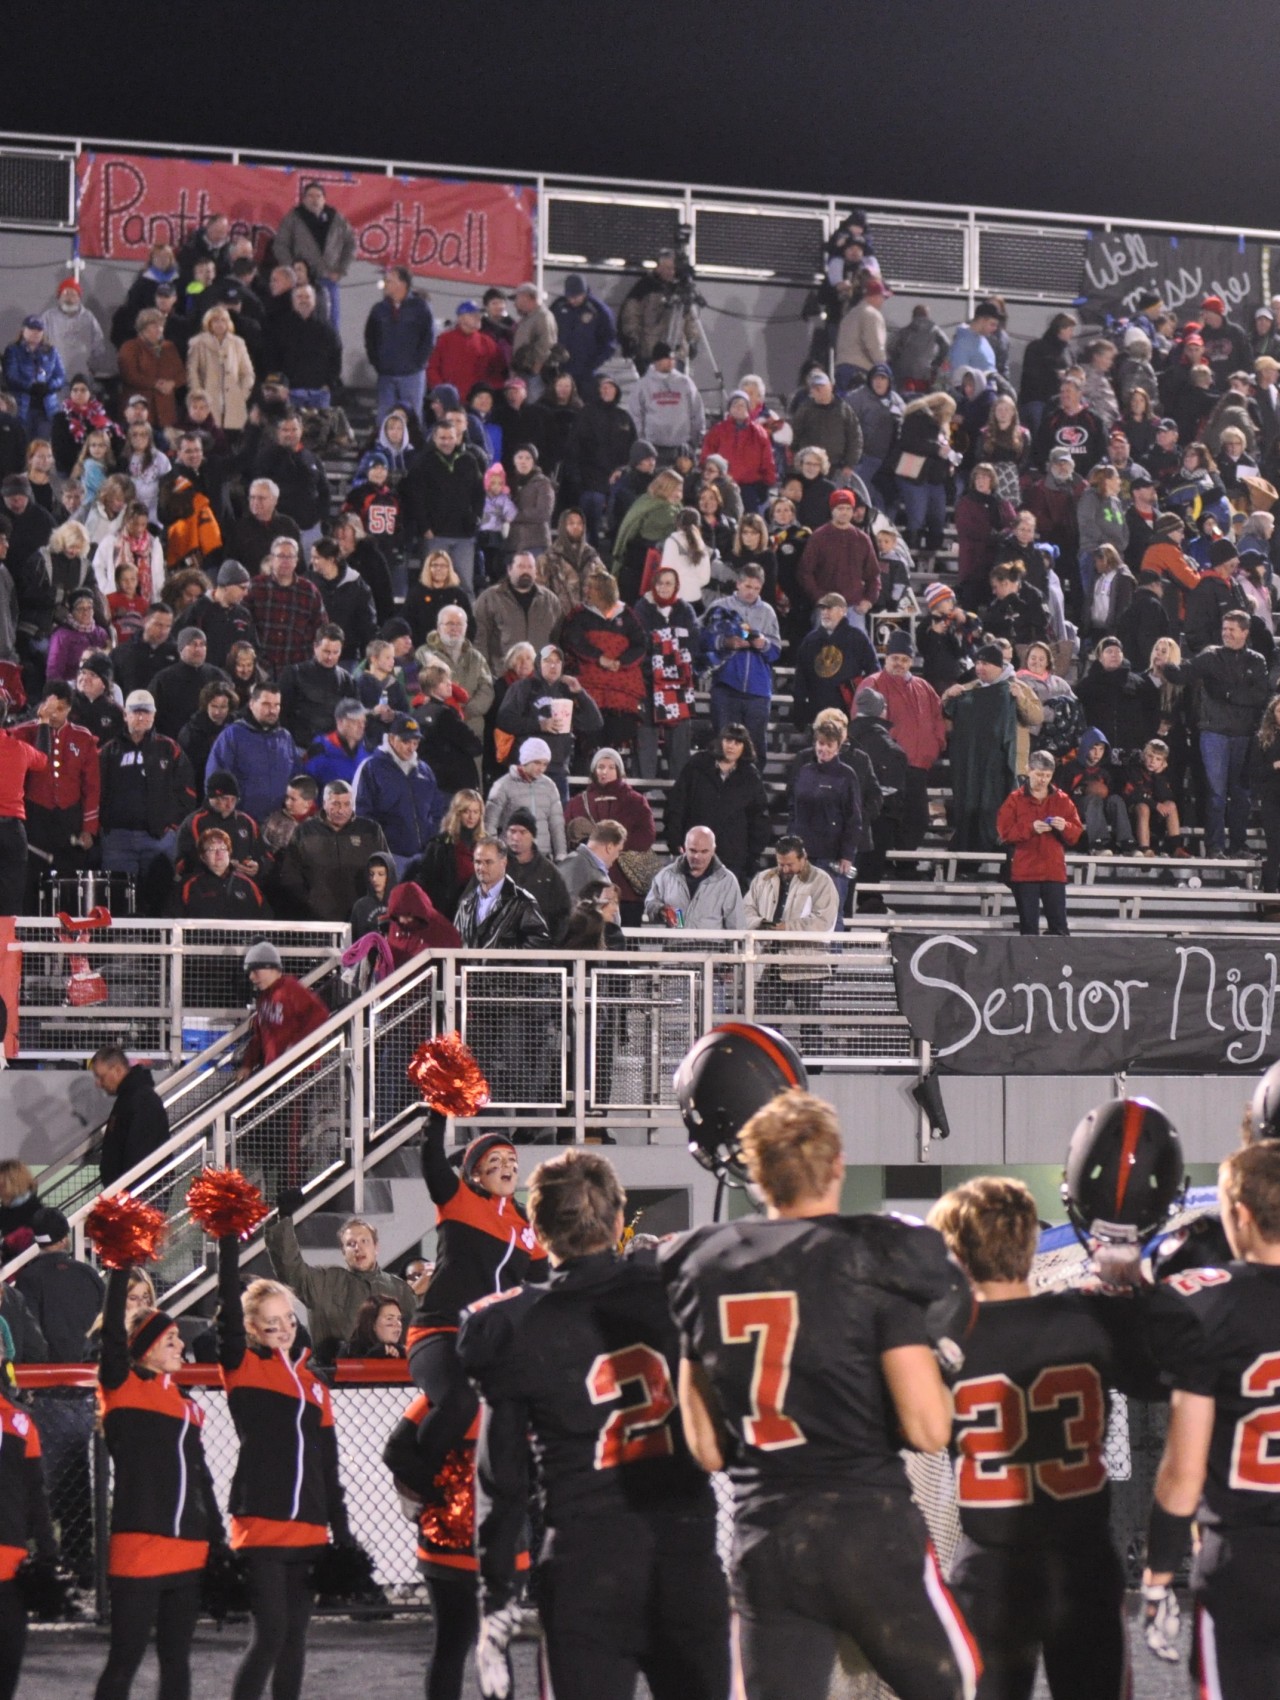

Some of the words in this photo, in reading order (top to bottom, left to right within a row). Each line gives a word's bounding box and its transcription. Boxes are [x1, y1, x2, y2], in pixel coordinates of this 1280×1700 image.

[299, 174, 487, 275] Fotball
[1202, 272, 1250, 316] he
[910, 935, 1149, 1057] Senior
[718, 1290, 808, 1451] 7
[953, 1362, 1109, 1508] 23
